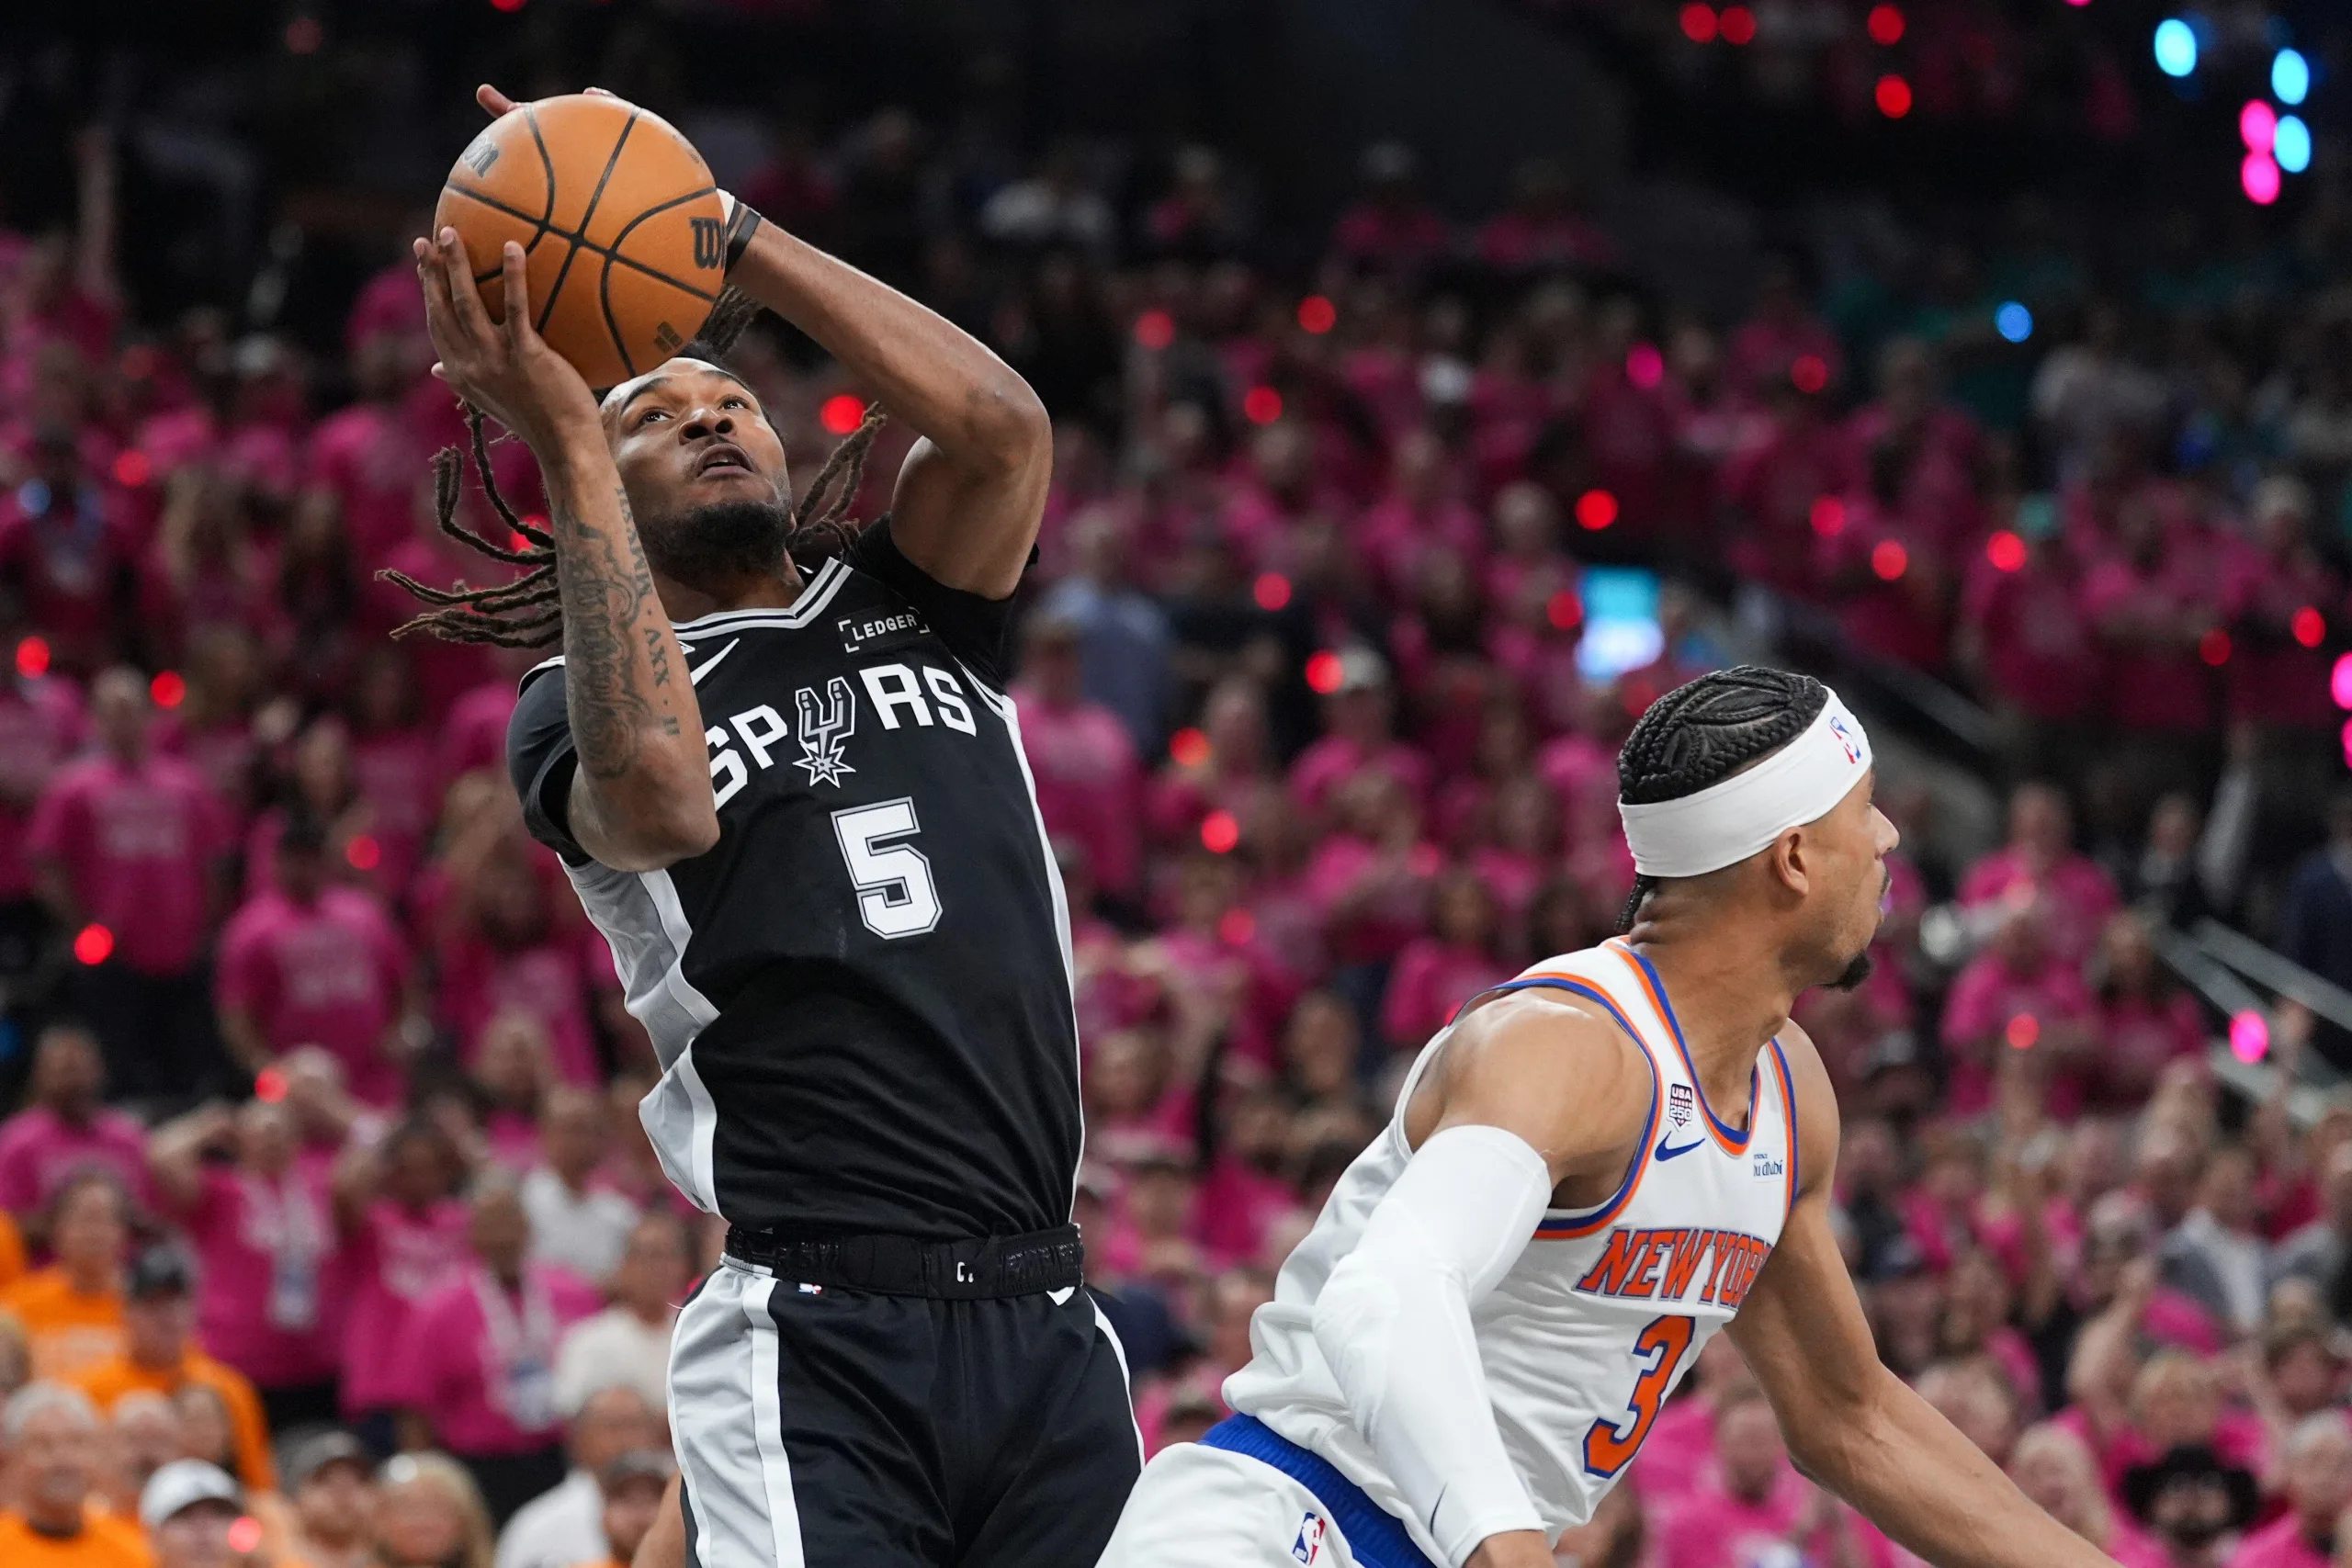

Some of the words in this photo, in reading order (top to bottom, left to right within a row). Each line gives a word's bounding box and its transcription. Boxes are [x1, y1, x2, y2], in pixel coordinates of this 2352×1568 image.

[852, 614, 918, 641] LEDGER
[831, 795, 943, 941] 5
[1670, 1105, 1691, 1121] 250
[1672, 1086, 1691, 1101] USA
[1571, 1227, 1716, 1302] NEW
[1583, 1314, 1696, 1479] 3
